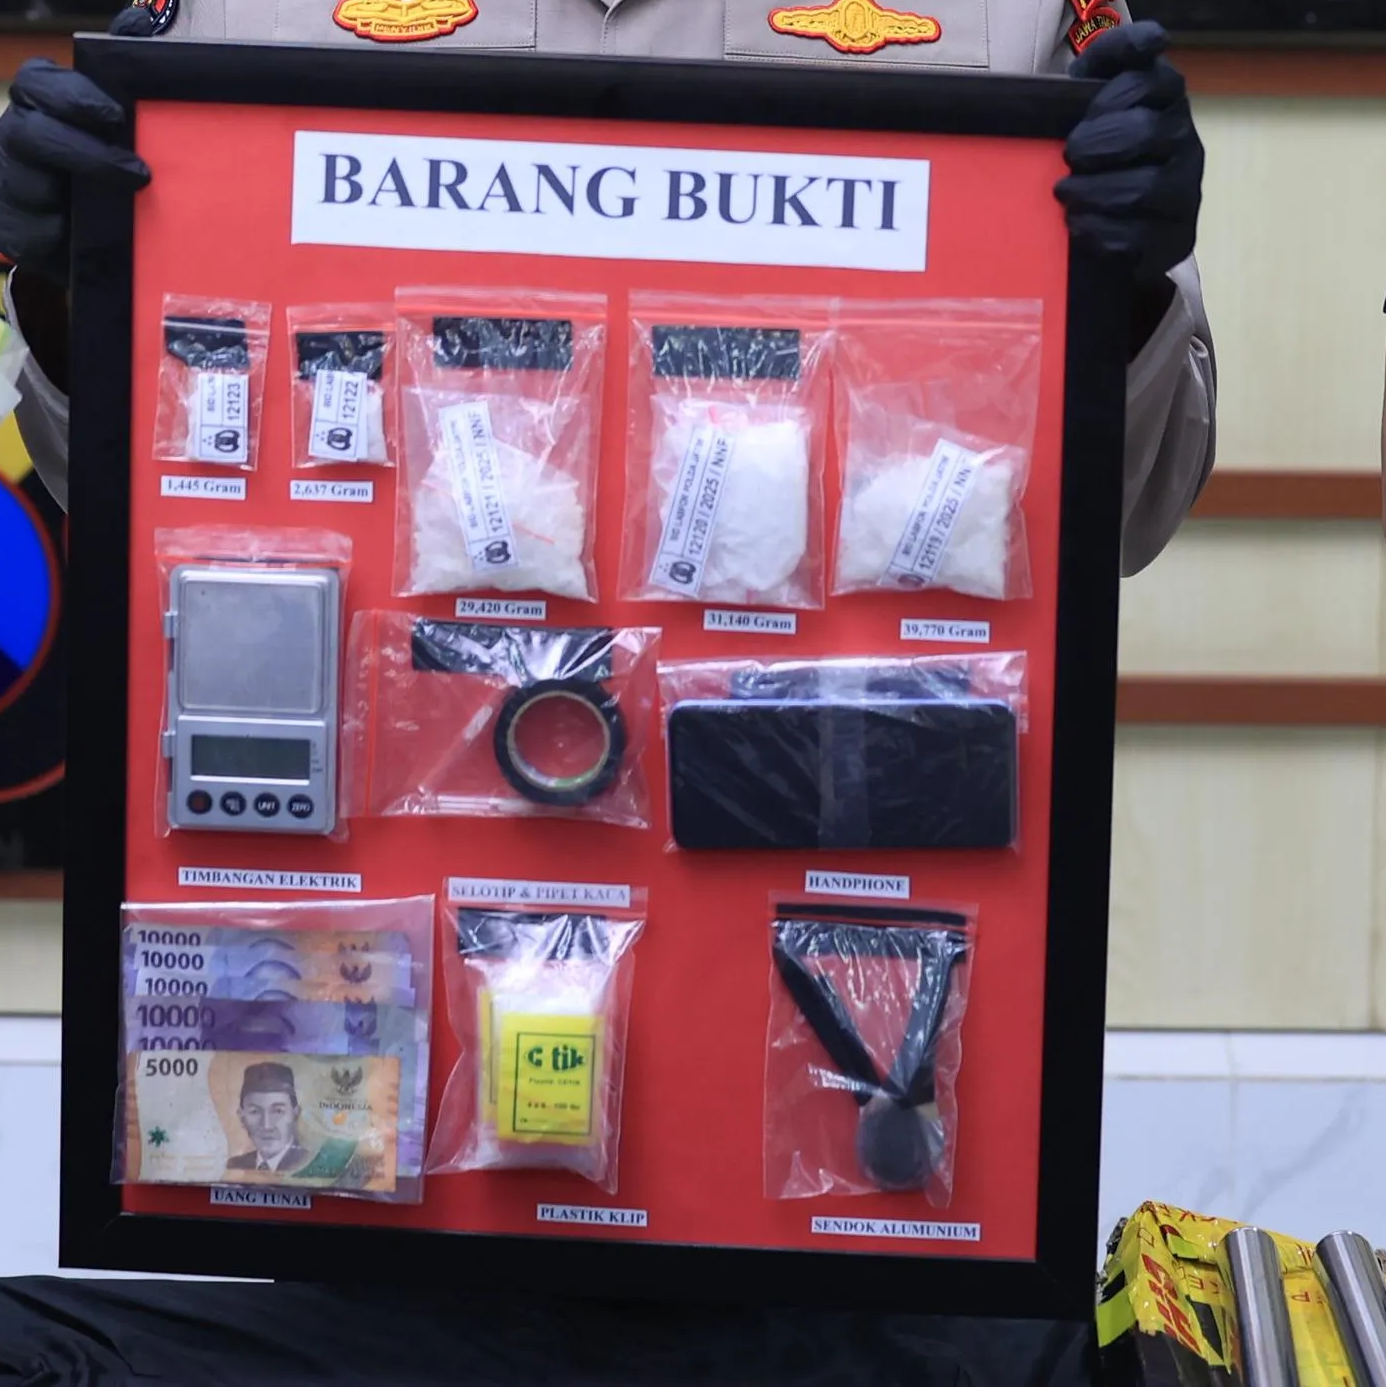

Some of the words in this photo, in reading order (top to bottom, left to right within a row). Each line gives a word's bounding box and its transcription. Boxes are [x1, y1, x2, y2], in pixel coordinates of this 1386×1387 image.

[320, 152, 639, 219] BARANG
[664, 169, 901, 231] BUKTI
[227, 382, 240, 420] 12123
[342, 380, 358, 419] 12122
[167, 480, 199, 494] 1,445
[203, 481, 242, 494] Gram
[294, 482, 327, 497] 2,637
[331, 483, 369, 497] Gram
[699, 476, 720, 510] 2025
[936, 495, 960, 528] 2025
[459, 600, 500, 616] 29,420
[503, 602, 543, 617] Gram
[707, 613, 750, 629] 31,140
[753, 616, 792, 631] Gram
[903, 622, 945, 638] 39,770
[948, 624, 987, 639] Gram
[182, 870, 276, 886] TIMBANGAN
[279, 873, 357, 889] ELEKTRIK
[809, 875, 906, 892] HANDPHONE
[451, 885, 517, 900] SELOTIP
[520, 888, 532, 900] &
[536, 887, 579, 901] PIPET
[583, 888, 627, 902] KACA
[138, 930, 201, 946] 10000
[141, 951, 205, 970] 10000
[145, 978, 208, 996] 10000
[137, 1004, 215, 1027] 10000
[145, 1058, 198, 1076] 5000
[214, 1190, 256, 1204] UANG
[260, 1192, 310, 1206] TUNAI
[540, 1207, 606, 1222] PLASTIK
[608, 1211, 646, 1225] KLIP
[814, 1220, 876, 1234] SENDOK
[879, 1222, 977, 1238] ALUMUNIUM
